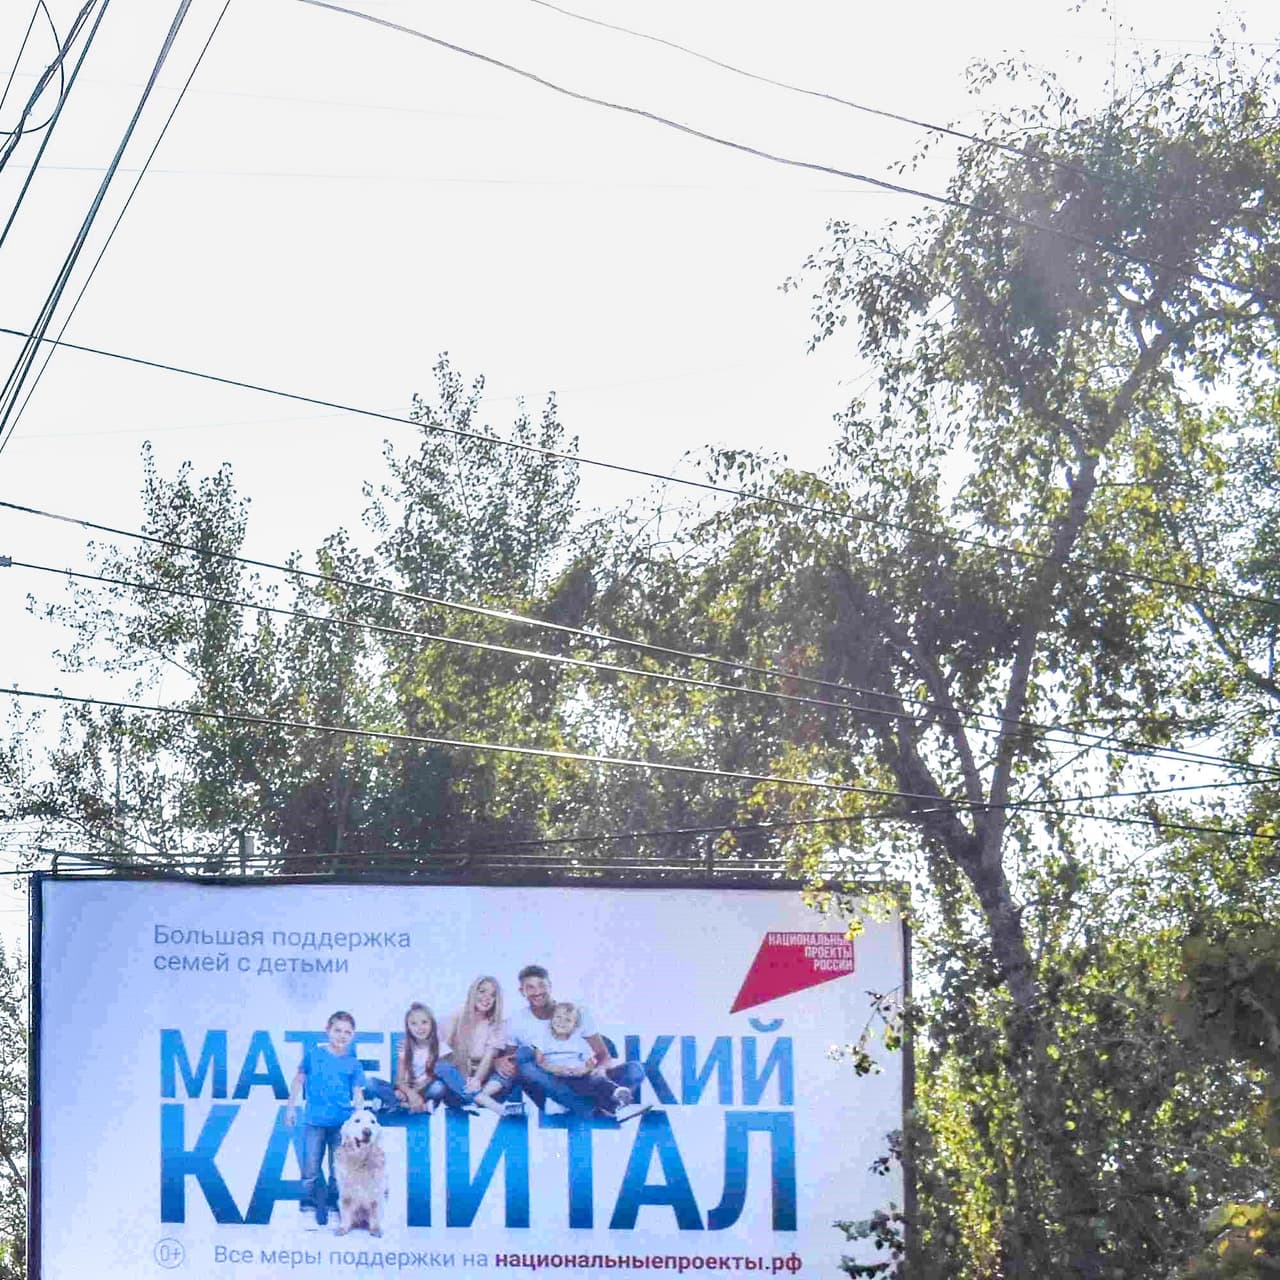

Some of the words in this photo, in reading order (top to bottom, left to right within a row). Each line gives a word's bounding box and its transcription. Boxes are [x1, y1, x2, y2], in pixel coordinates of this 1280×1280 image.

[154, 924, 264, 946] Большая
[272, 929, 411, 951] поддержка
[153, 952, 230, 972] семей
[237, 957, 251, 972] с
[257, 957, 349, 976] детьми
[804, 946, 853, 958] ПРОЕКТЫ
[813, 959, 853, 971] РОССИИ
[214, 1246, 253, 1264] Все
[261, 1251, 322, 1268] меры
[329, 1250, 455, 1270] поддержки
[464, 1253, 489, 1267] на
[495, 1253, 803, 1274] национальныепроекты.рф
